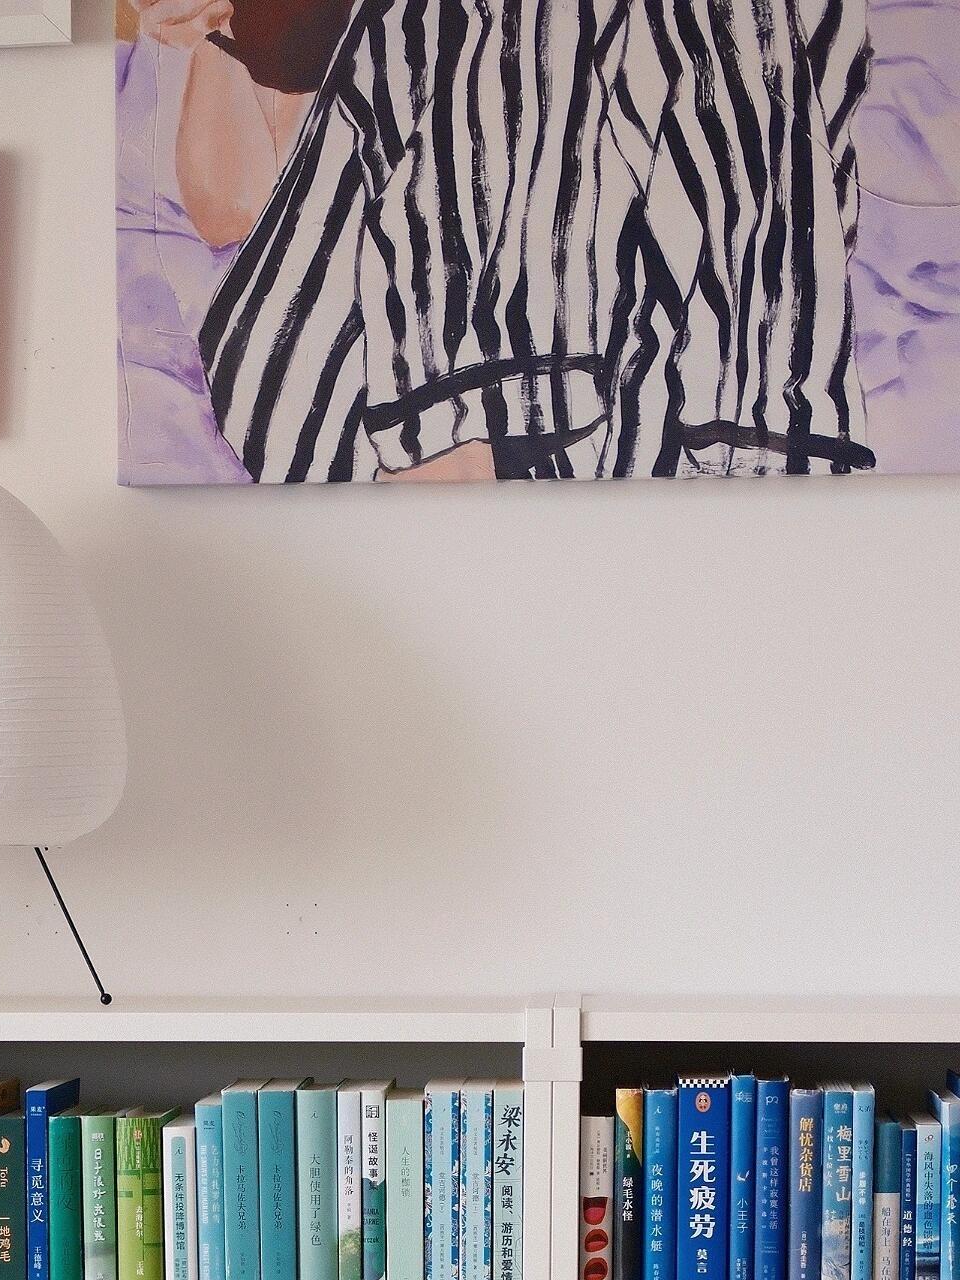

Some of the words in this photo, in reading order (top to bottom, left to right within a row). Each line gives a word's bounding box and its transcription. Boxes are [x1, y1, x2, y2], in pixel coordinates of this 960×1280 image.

[343, 1135, 354, 1196] 阿勒泰的角落
[368, 1132, 379, 1191] 怪诞故事集
[495, 1104, 522, 1176] 梁永安
[625, 1131, 633, 1150] 王小波
[799, 1117, 814, 1192] 解忧杂货店
[836, 1124, 852, 1202] 梅里雪山
[0, 1167, 9, 1188] Tofu
[30, 1158, 45, 1222] 寻觅意义
[236, 1165, 247, 1230] 卡拉马佐夫兄弟
[272, 1165, 283, 1230] 卡拉马佐夫兄弟
[309, 1153, 322, 1246] 大胆使用了绿色
[622, 1176, 634, 1222] 绿毛水怪
[651, 1163, 663, 1252] 夜晚的潜水艇
[689, 1131, 716, 1239] 生死疲劳
[946, 1164, 958, 1224] 四个春天
[0, 1216, 12, 1262] 一地鸡毛
[175, 1173, 186, 1251] 无条件投降博物馆
[737, 1198, 749, 1233] 小王子
[881, 1206, 891, 1247] 船在海上
[903, 1210, 913, 1247] 道德经
[34, 1246, 43, 1270] 王德峰
[696, 1248, 708, 1274] 莫言
